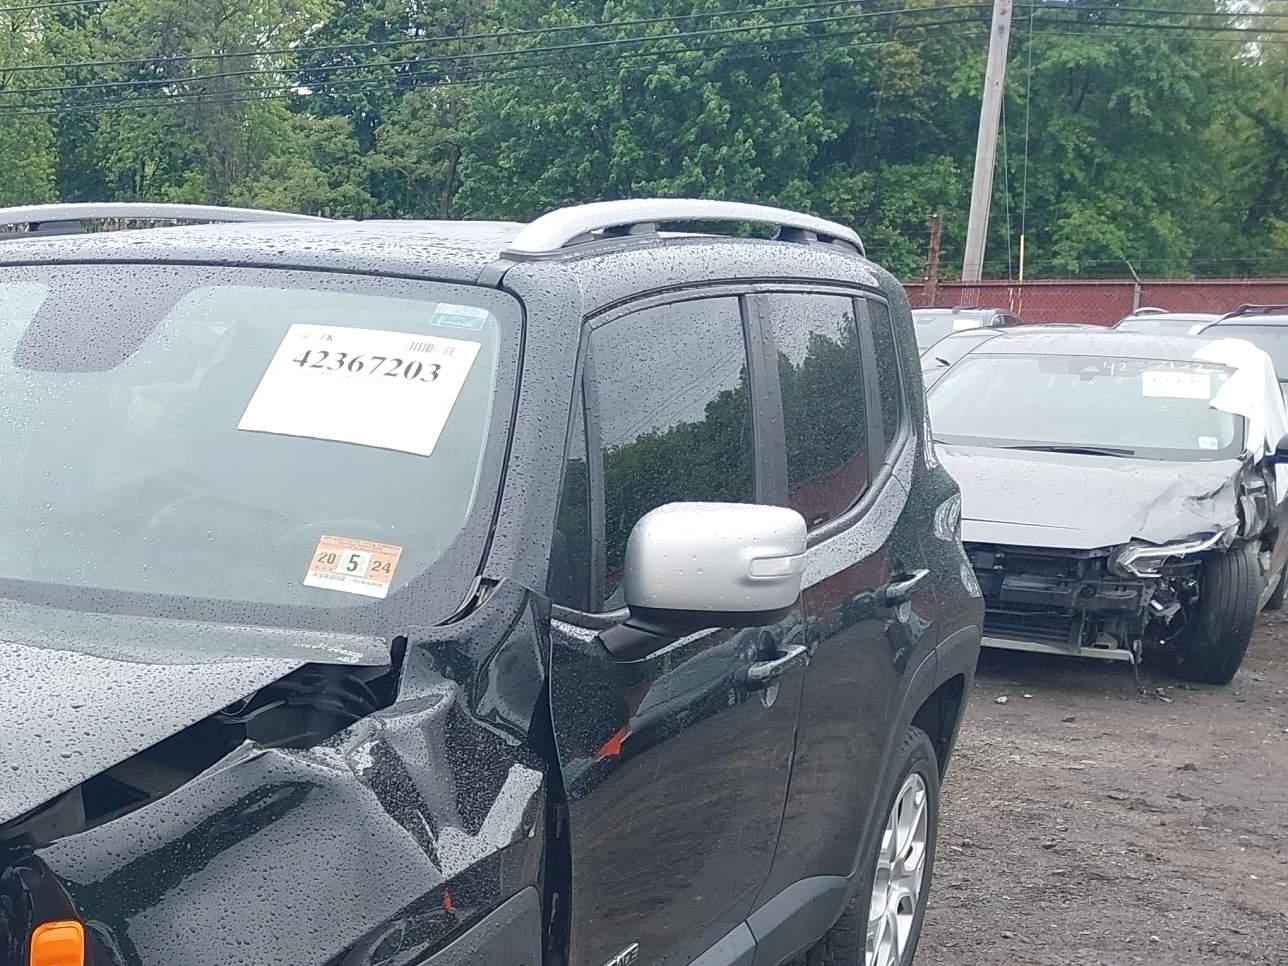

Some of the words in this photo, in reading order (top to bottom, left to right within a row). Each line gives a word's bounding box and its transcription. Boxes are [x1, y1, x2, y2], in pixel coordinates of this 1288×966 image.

[292, 349, 441, 382] 42367203
[318, 551, 337, 565] 20
[346, 554, 360, 572] 5
[371, 560, 392, 574] 24
